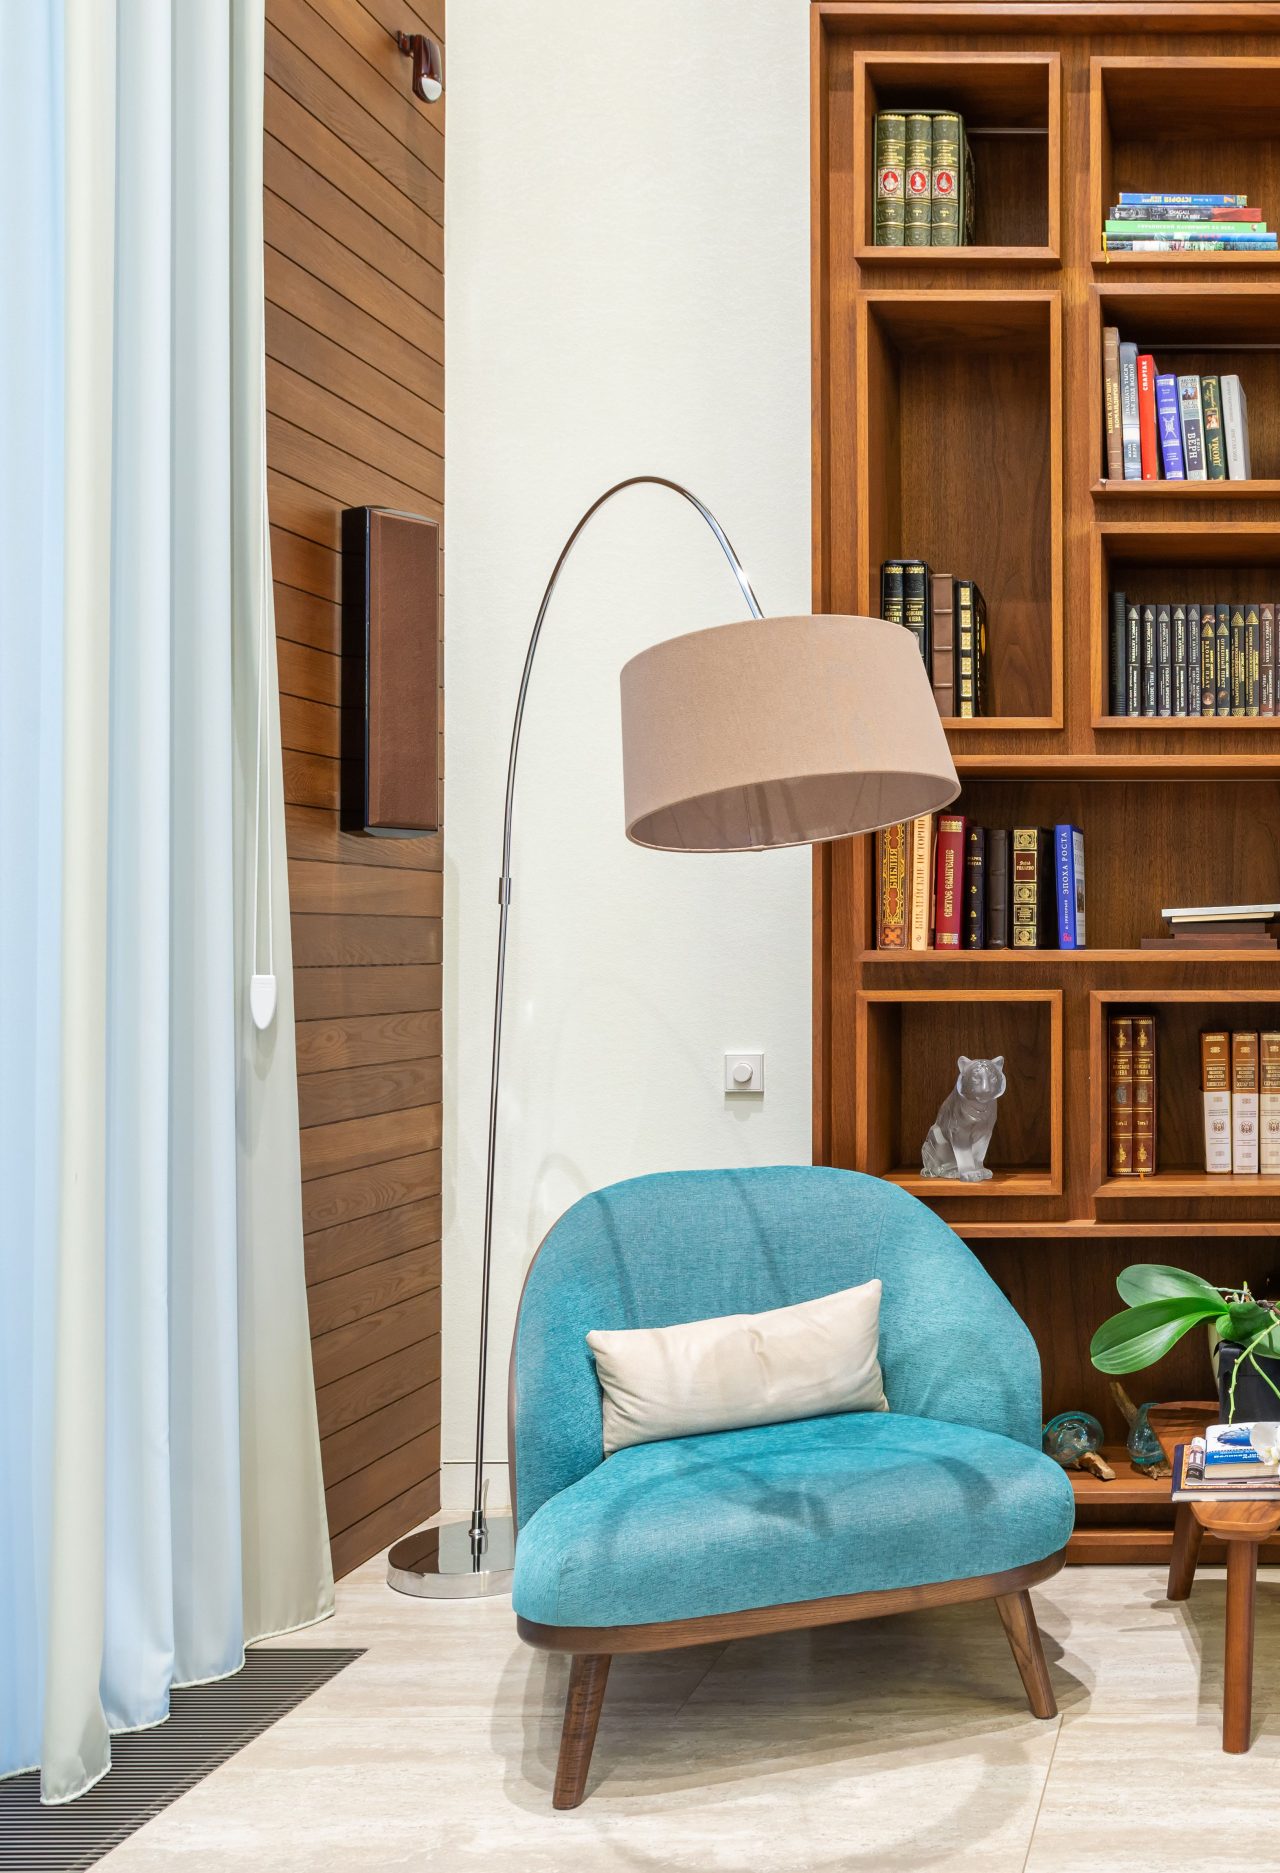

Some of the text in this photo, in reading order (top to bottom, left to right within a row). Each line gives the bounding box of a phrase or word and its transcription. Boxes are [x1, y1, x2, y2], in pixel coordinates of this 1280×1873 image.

[1187, 433, 1198, 459] ВЕРН
[1212, 436, 1222, 467] ДЮМА
[889, 848, 899, 889] БИБЛИЯ
